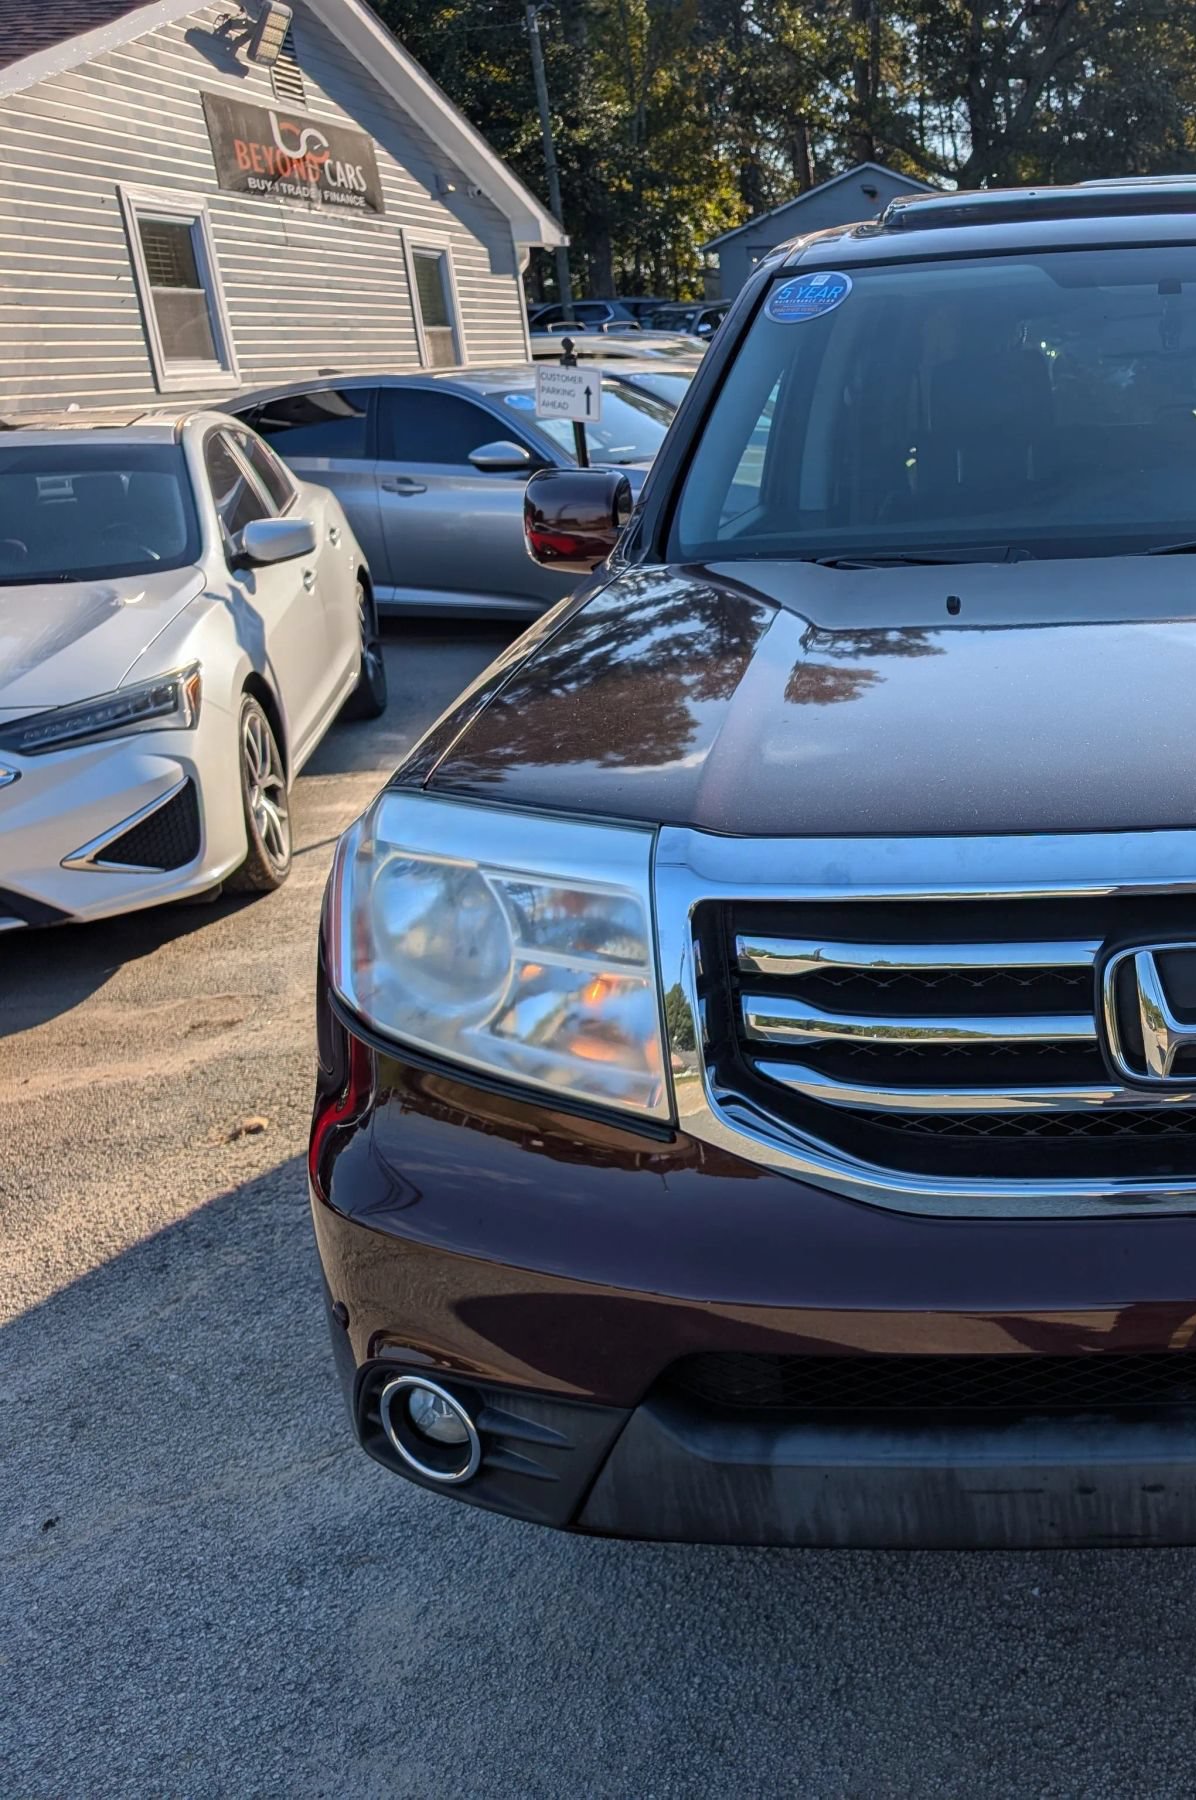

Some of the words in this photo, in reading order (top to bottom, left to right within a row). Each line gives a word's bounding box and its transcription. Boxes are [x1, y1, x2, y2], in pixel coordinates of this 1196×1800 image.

[234, 139, 322, 182] BEYOND
[324, 159, 368, 192] CARS
[247, 177, 273, 192] BUY
[280, 183, 317, 199] TRADE
[323, 190, 367, 207] FINANCE
[778, 287, 794, 300] 5
[795, 286, 844, 299] YEAR
[540, 371, 584, 384] CUSTOMER
[541, 385, 576, 397] PARKING
[541, 399, 569, 410] AHEAD
